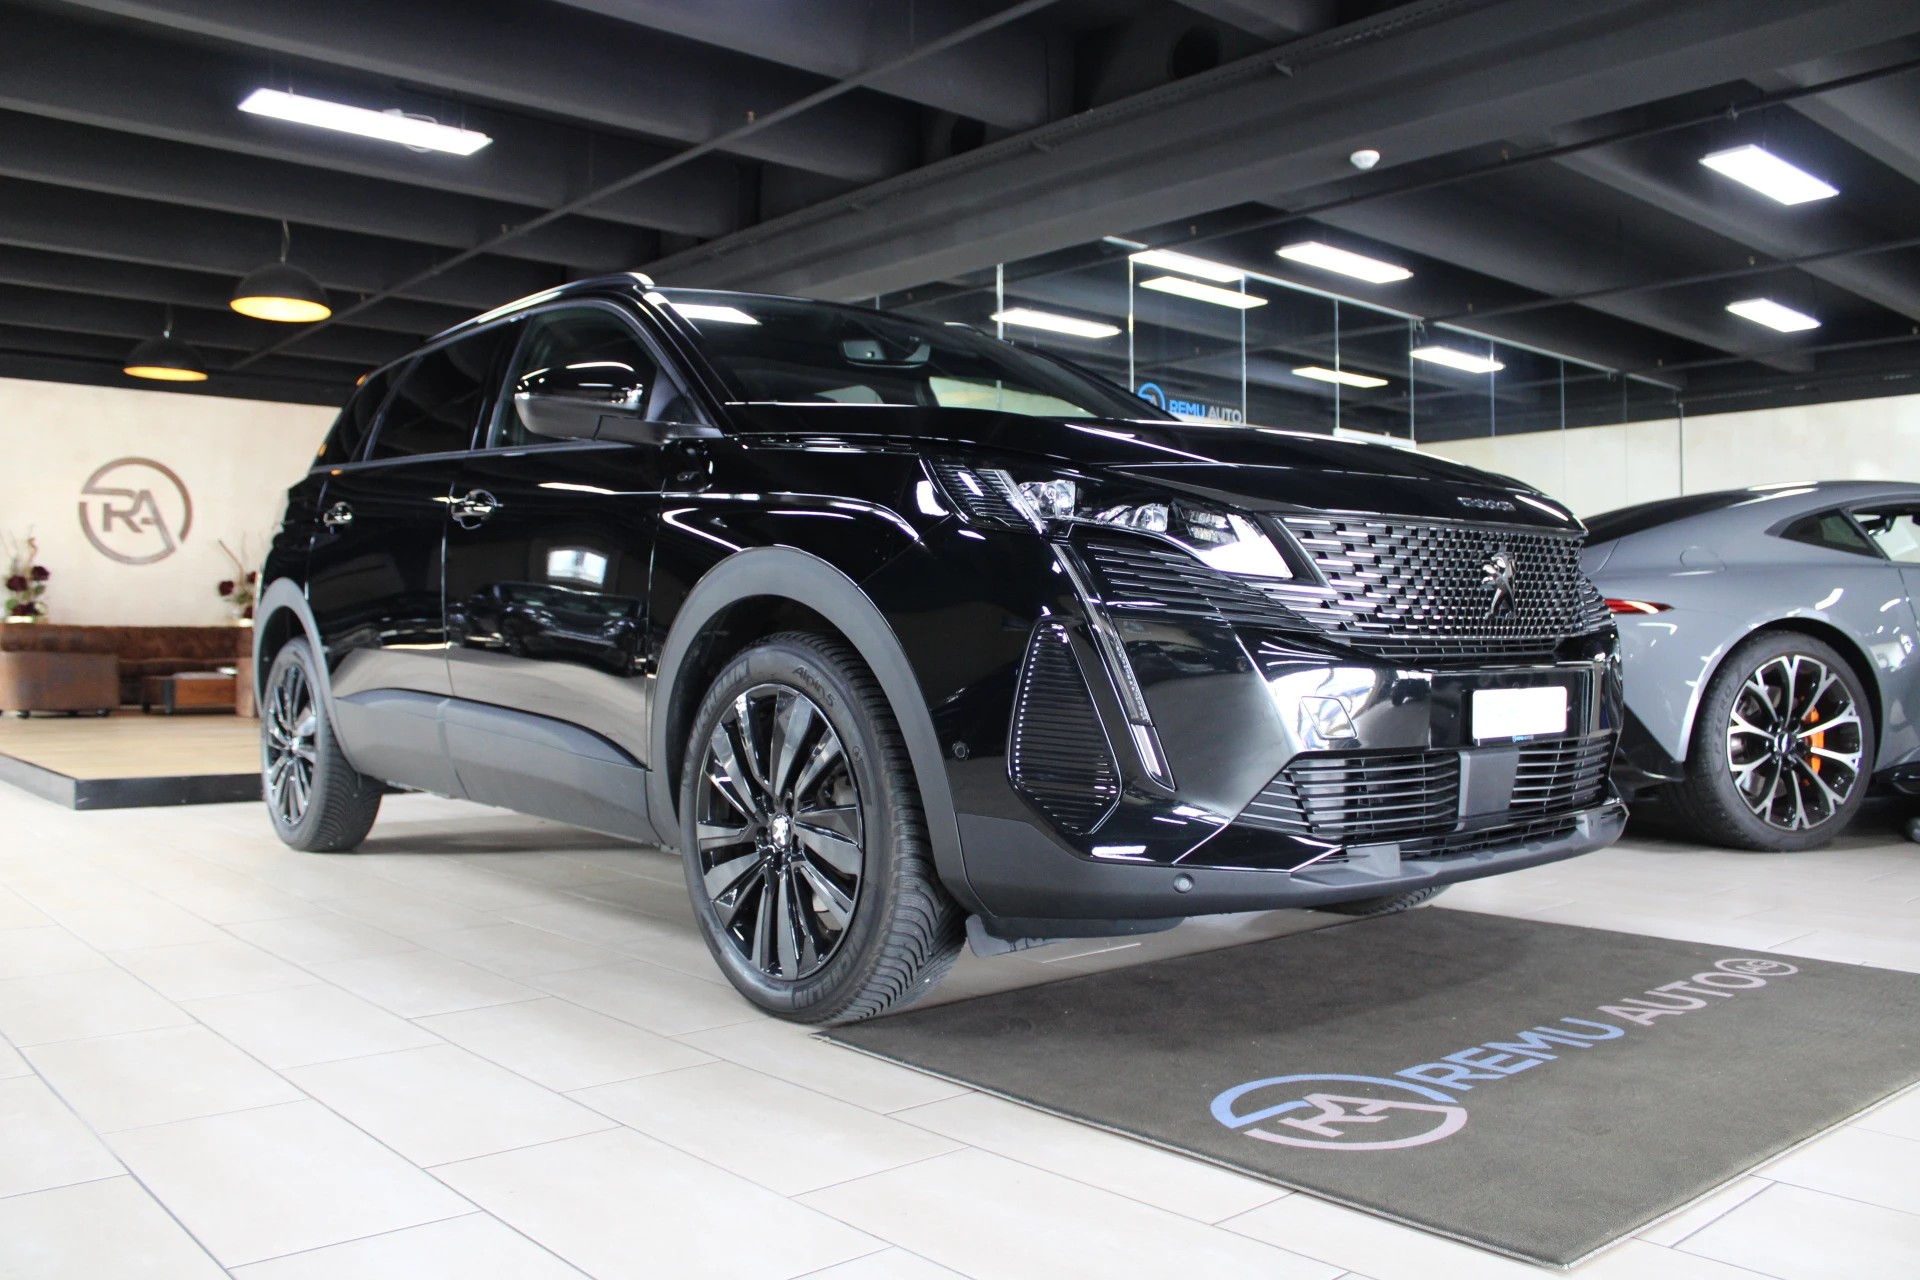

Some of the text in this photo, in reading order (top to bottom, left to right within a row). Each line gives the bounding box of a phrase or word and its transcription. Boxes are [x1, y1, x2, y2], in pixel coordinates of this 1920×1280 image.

[1169, 399, 1206, 418] REMU
[1208, 405, 1243, 423] AUTO
[792, 666, 826, 699] Alpin
[1393, 1016, 1625, 1091] REMU
[1597, 972, 1767, 1026] AUTO
